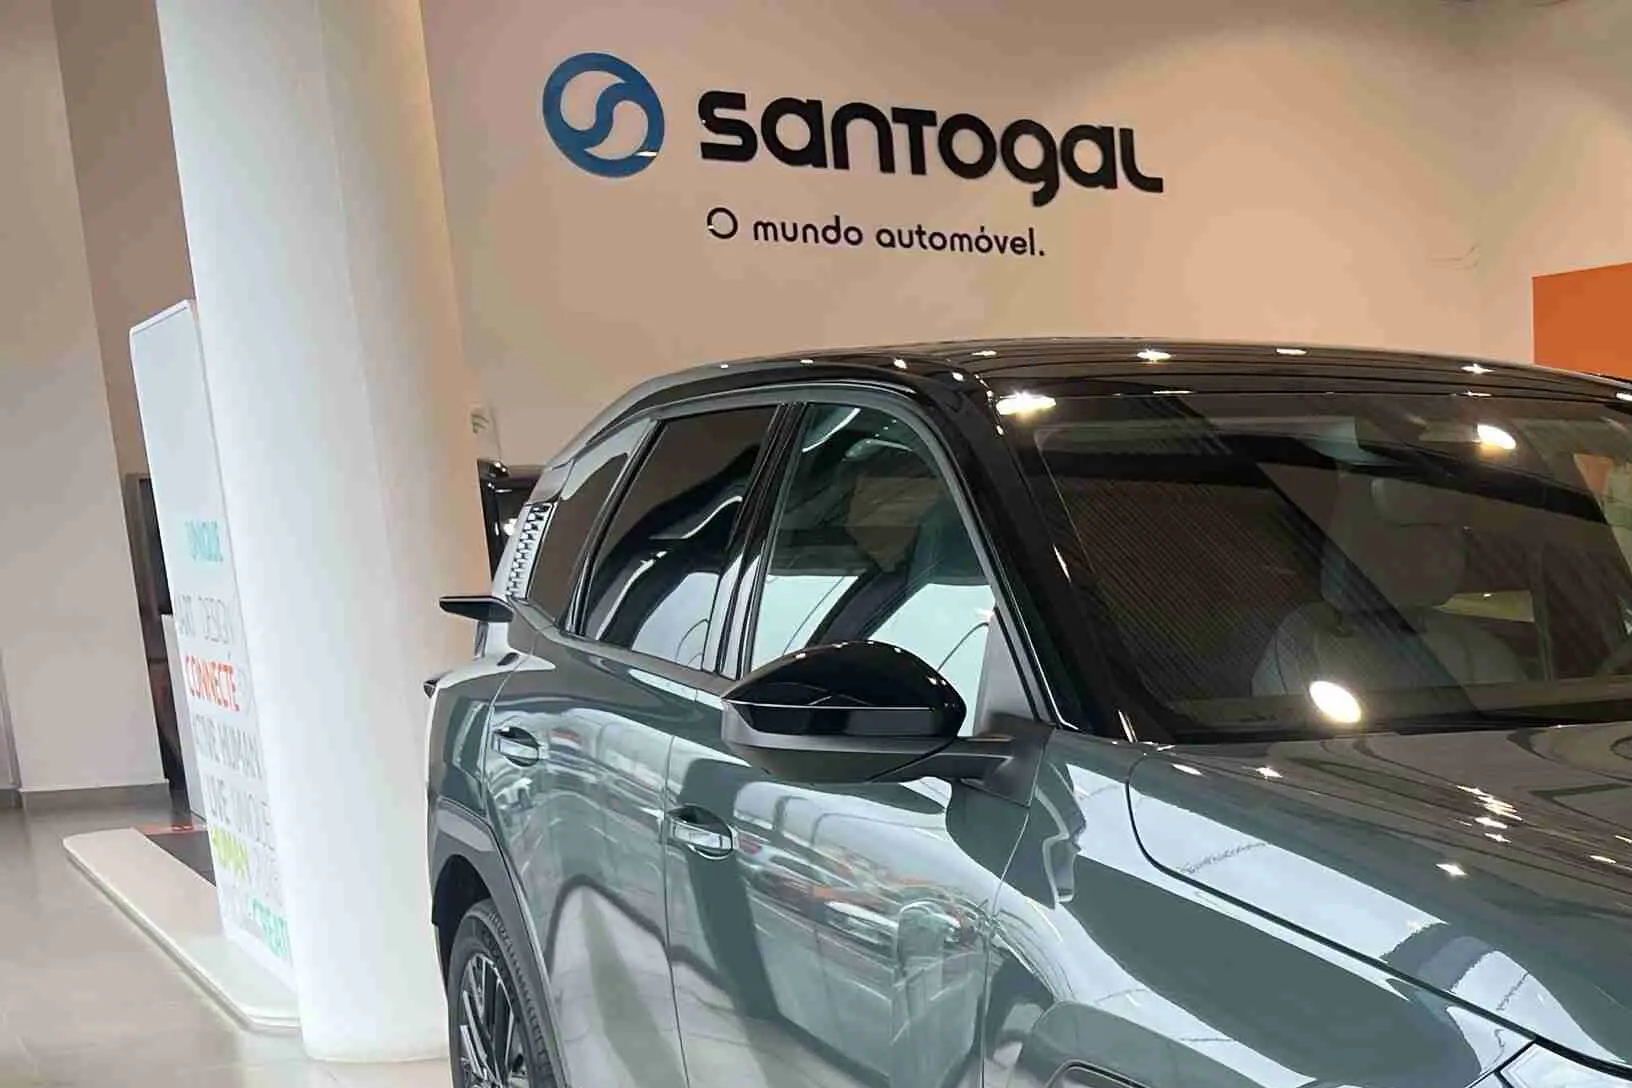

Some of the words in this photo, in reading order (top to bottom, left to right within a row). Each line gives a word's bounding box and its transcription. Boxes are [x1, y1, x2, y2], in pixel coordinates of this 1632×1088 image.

[706, 206, 739, 240] O
[752, 214, 864, 247] mundo
[875, 225, 1046, 257] automóvel.
